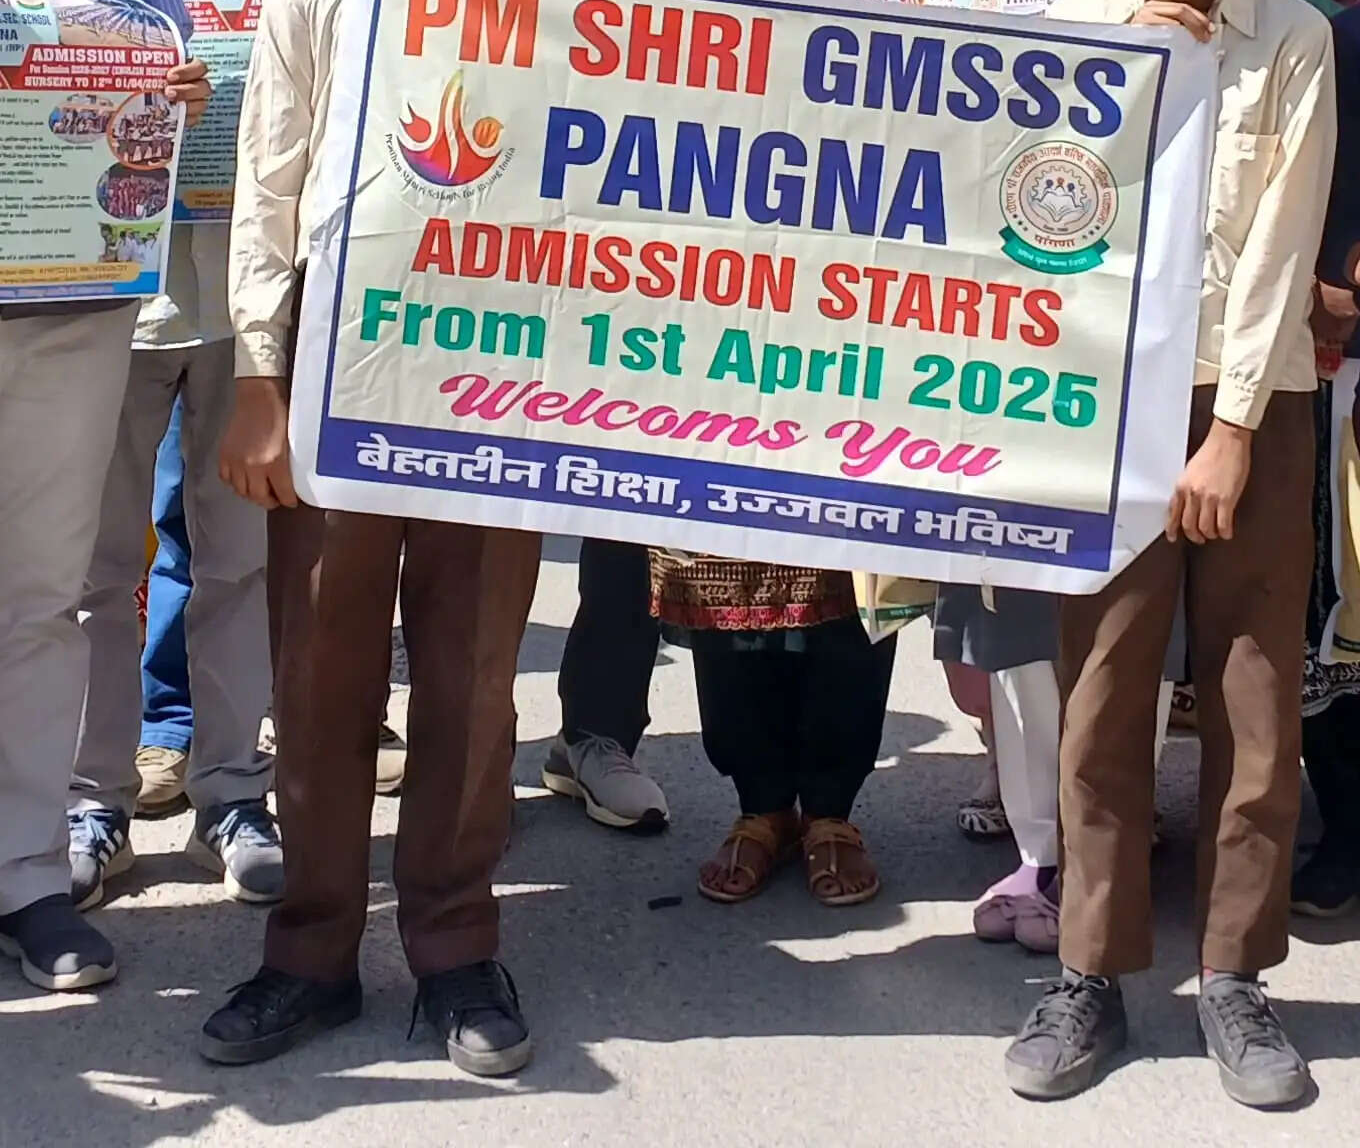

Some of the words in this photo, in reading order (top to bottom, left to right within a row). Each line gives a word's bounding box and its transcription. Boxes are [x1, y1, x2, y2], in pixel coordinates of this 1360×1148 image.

[22, 13, 52, 26] SCHOOL
[32, 48, 126, 63] ADMISSION
[131, 50, 175, 64] OPEN
[25, 76, 72, 87] NURSERY
[75, 77, 89, 87] TO
[802, 25, 1127, 138] GMSSS
[384, 133, 401, 172] Pradhan
[539, 106, 947, 245] PANGNA
[410, 217, 796, 314] ADMISSION
[817, 263, 1063, 347] STARTS
[1035, 234, 1076, 248] पांगणा
[360, 288, 547, 359] From
[581, 314, 686, 376] 1st
[706, 328, 885, 400] April
[908, 353, 1098, 428] 2025
[439, 373, 809, 451] Welcoms
[825, 418, 1003, 478] You
[356, 432, 547, 489] बेहतरीन
[555, 454, 693, 515] शिक्षा,
[706, 482, 906, 534] उज्जवल
[914, 505, 1074, 556] भविष्य
